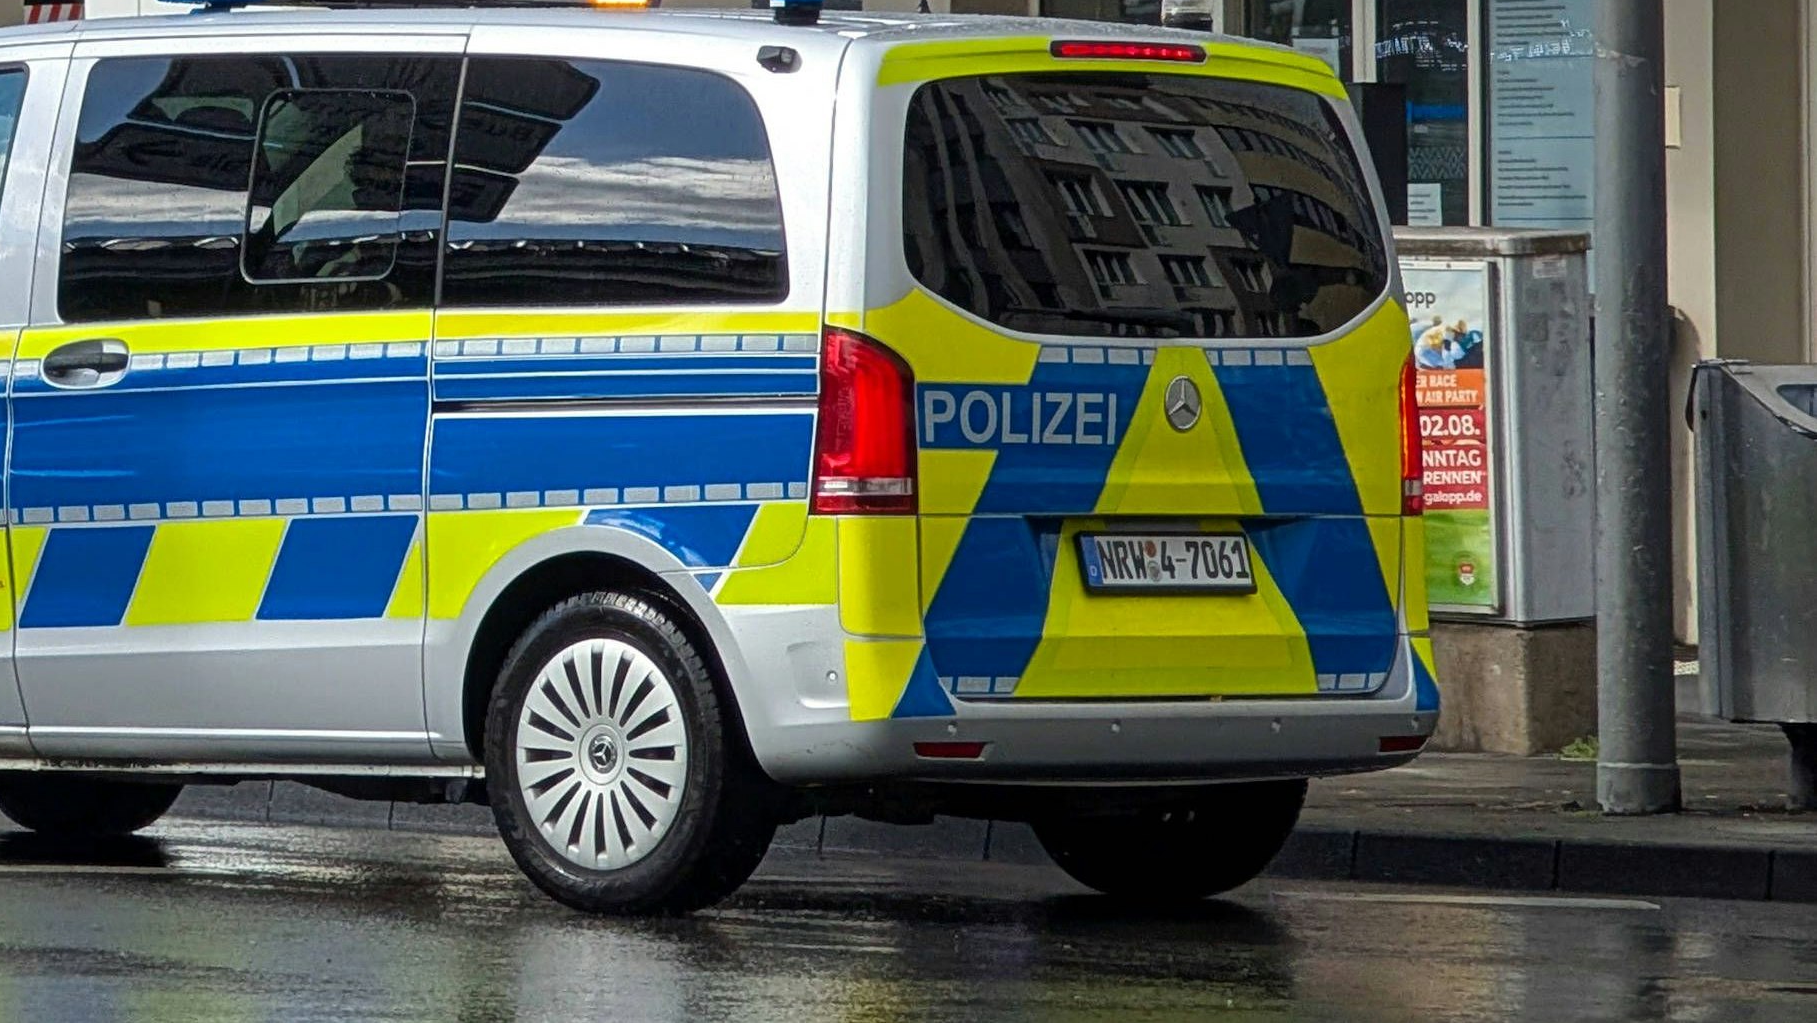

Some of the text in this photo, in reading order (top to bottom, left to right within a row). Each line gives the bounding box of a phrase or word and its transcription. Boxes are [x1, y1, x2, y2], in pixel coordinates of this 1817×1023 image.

[1405, 291, 1436, 308] opp
[1445, 389, 1478, 403] PARTY
[924, 389, 1116, 446] POLIZEI
[1419, 414, 1481, 437] 02.08.
[1422, 449, 1481, 467] NNTAG
[1096, 540, 1148, 579] NRW
[1160, 540, 1250, 579] 4-7061
